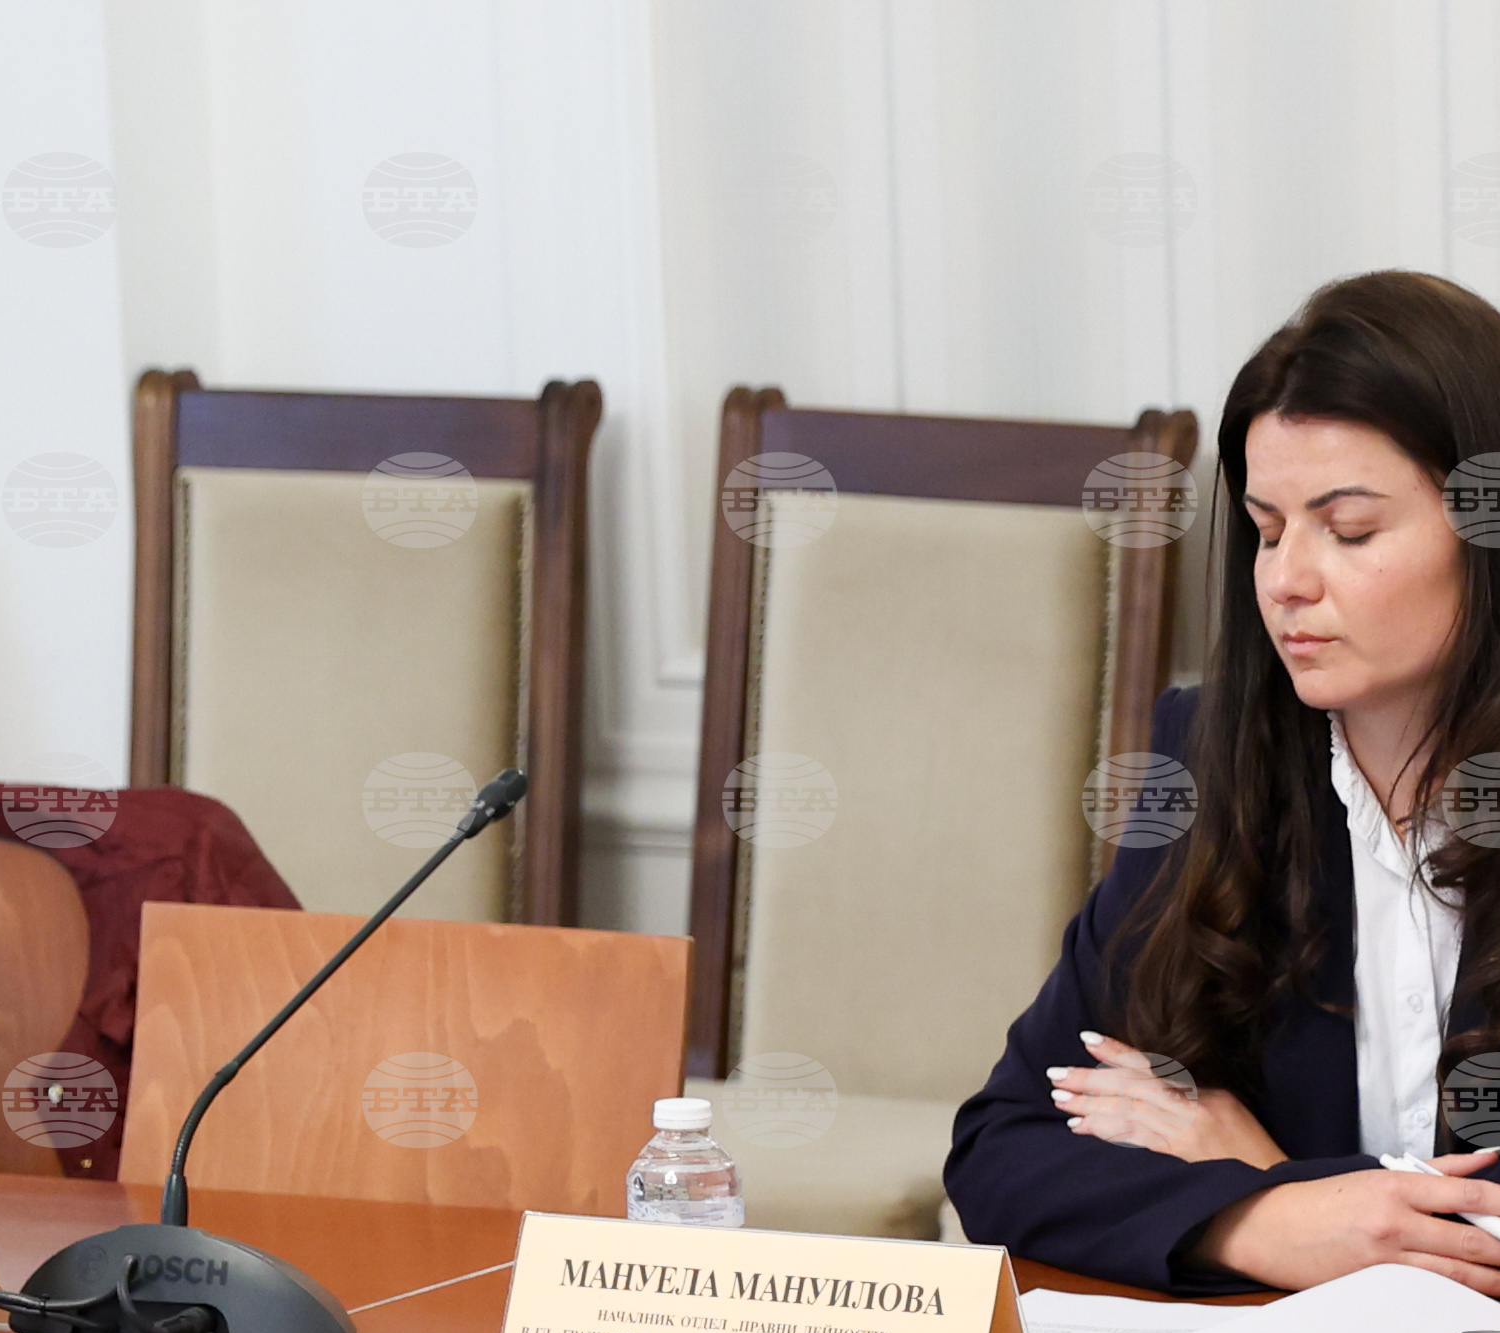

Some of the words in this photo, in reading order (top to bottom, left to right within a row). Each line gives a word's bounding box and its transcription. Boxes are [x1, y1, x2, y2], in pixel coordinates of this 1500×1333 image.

[130, 1254, 229, 1286] OSCH
[559, 1258, 719, 1298] МАНУЕЛА
[729, 1271, 945, 1316] МАНУИЛОВА
[597, 1309, 675, 1327] НАЧАЛНИК
[680, 1315, 728, 1331] ОТДЕЛ
